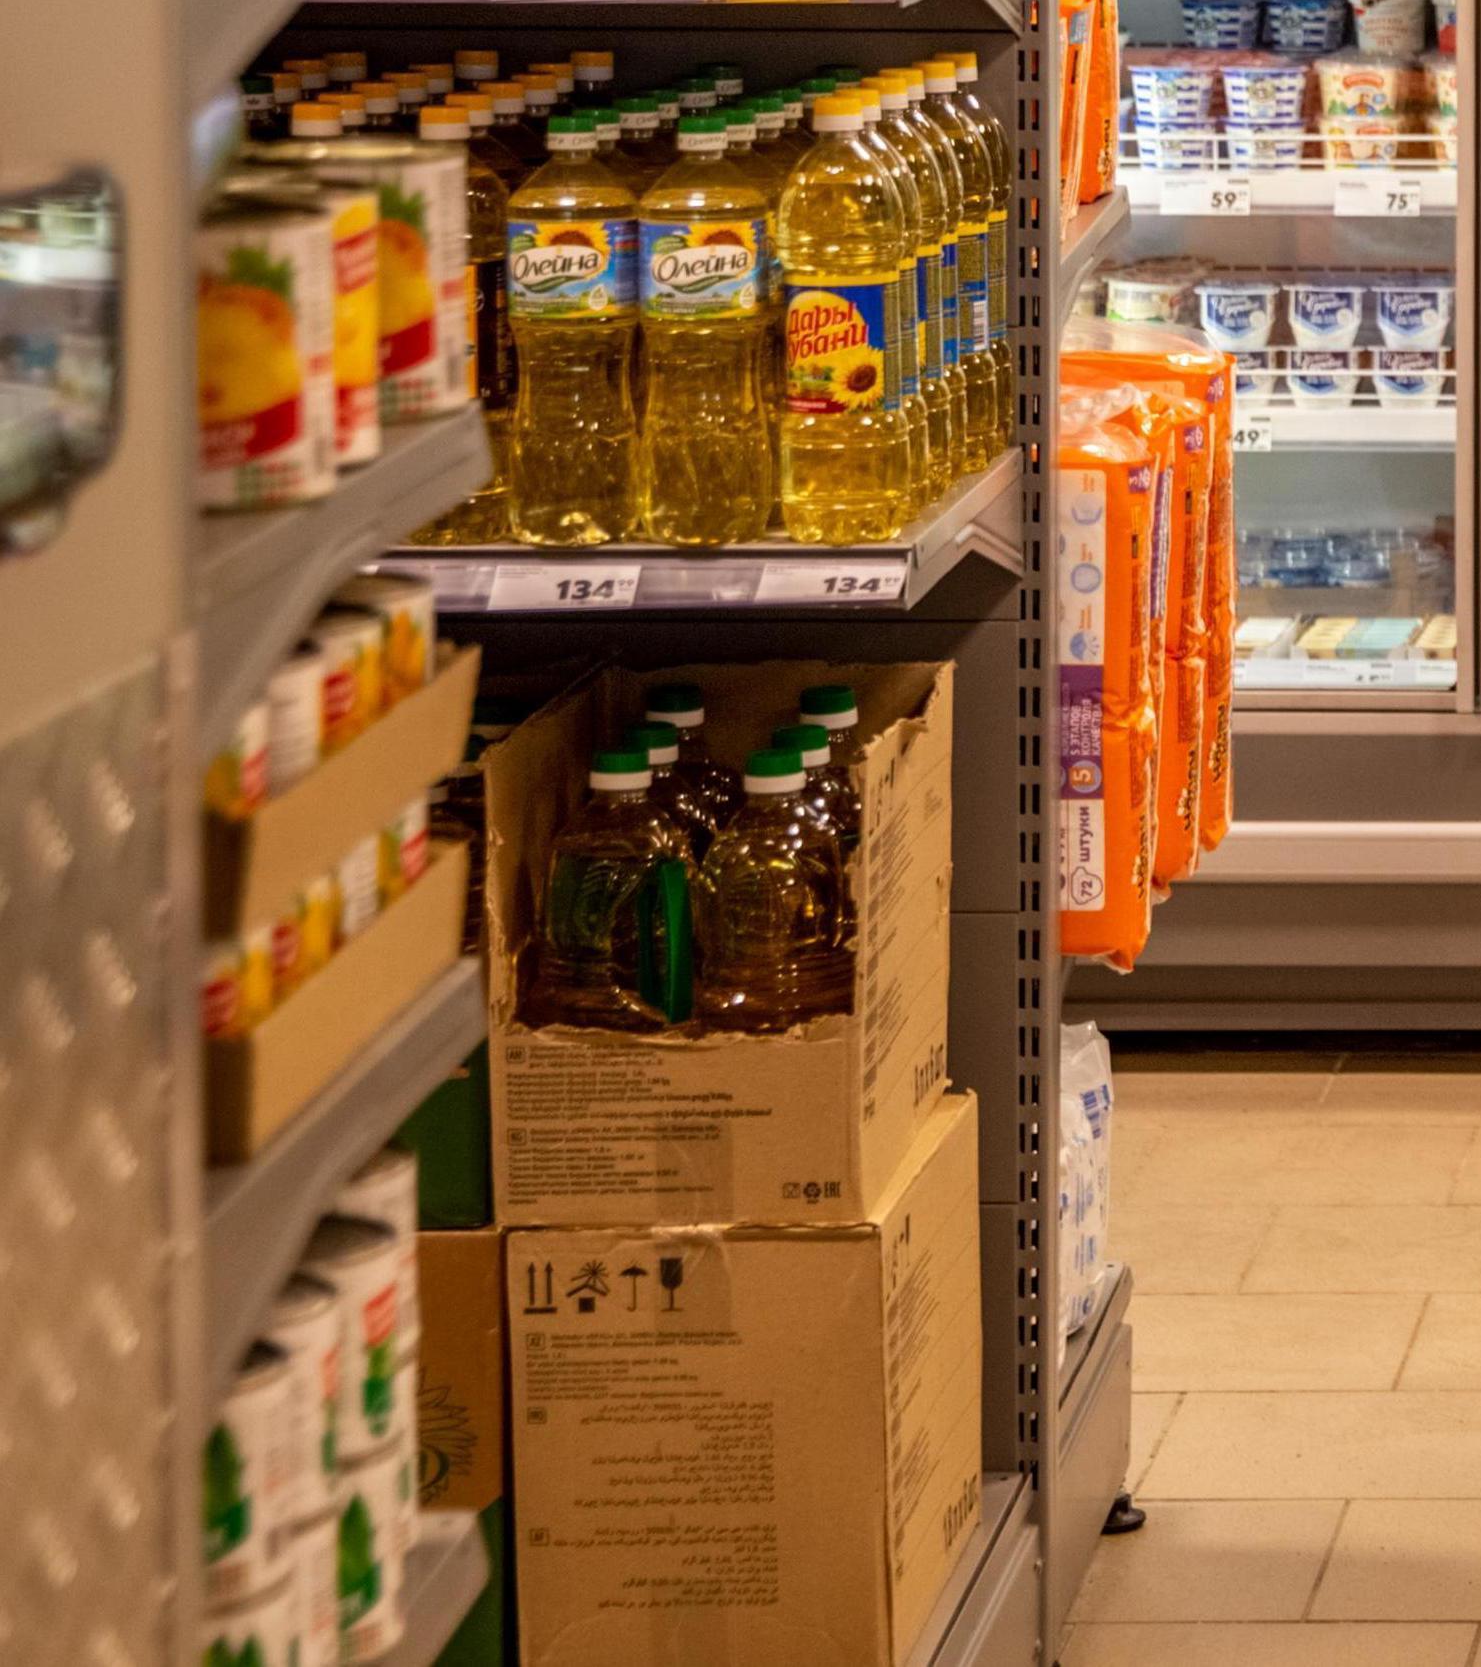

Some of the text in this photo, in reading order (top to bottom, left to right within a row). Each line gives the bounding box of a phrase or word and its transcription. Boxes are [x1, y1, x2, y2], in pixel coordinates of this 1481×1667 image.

[1210, 192, 1237, 210] 59
[1386, 193, 1408, 210] 75
[513, 252, 601, 283] Олейна
[658, 251, 750, 283] Олейна
[788, 300, 857, 335] Дары
[556, 579, 614, 601] 134
[822, 576, 880, 595] 134
[1079, 806, 1091, 862] штуки
[1081, 879, 1093, 897] 72
